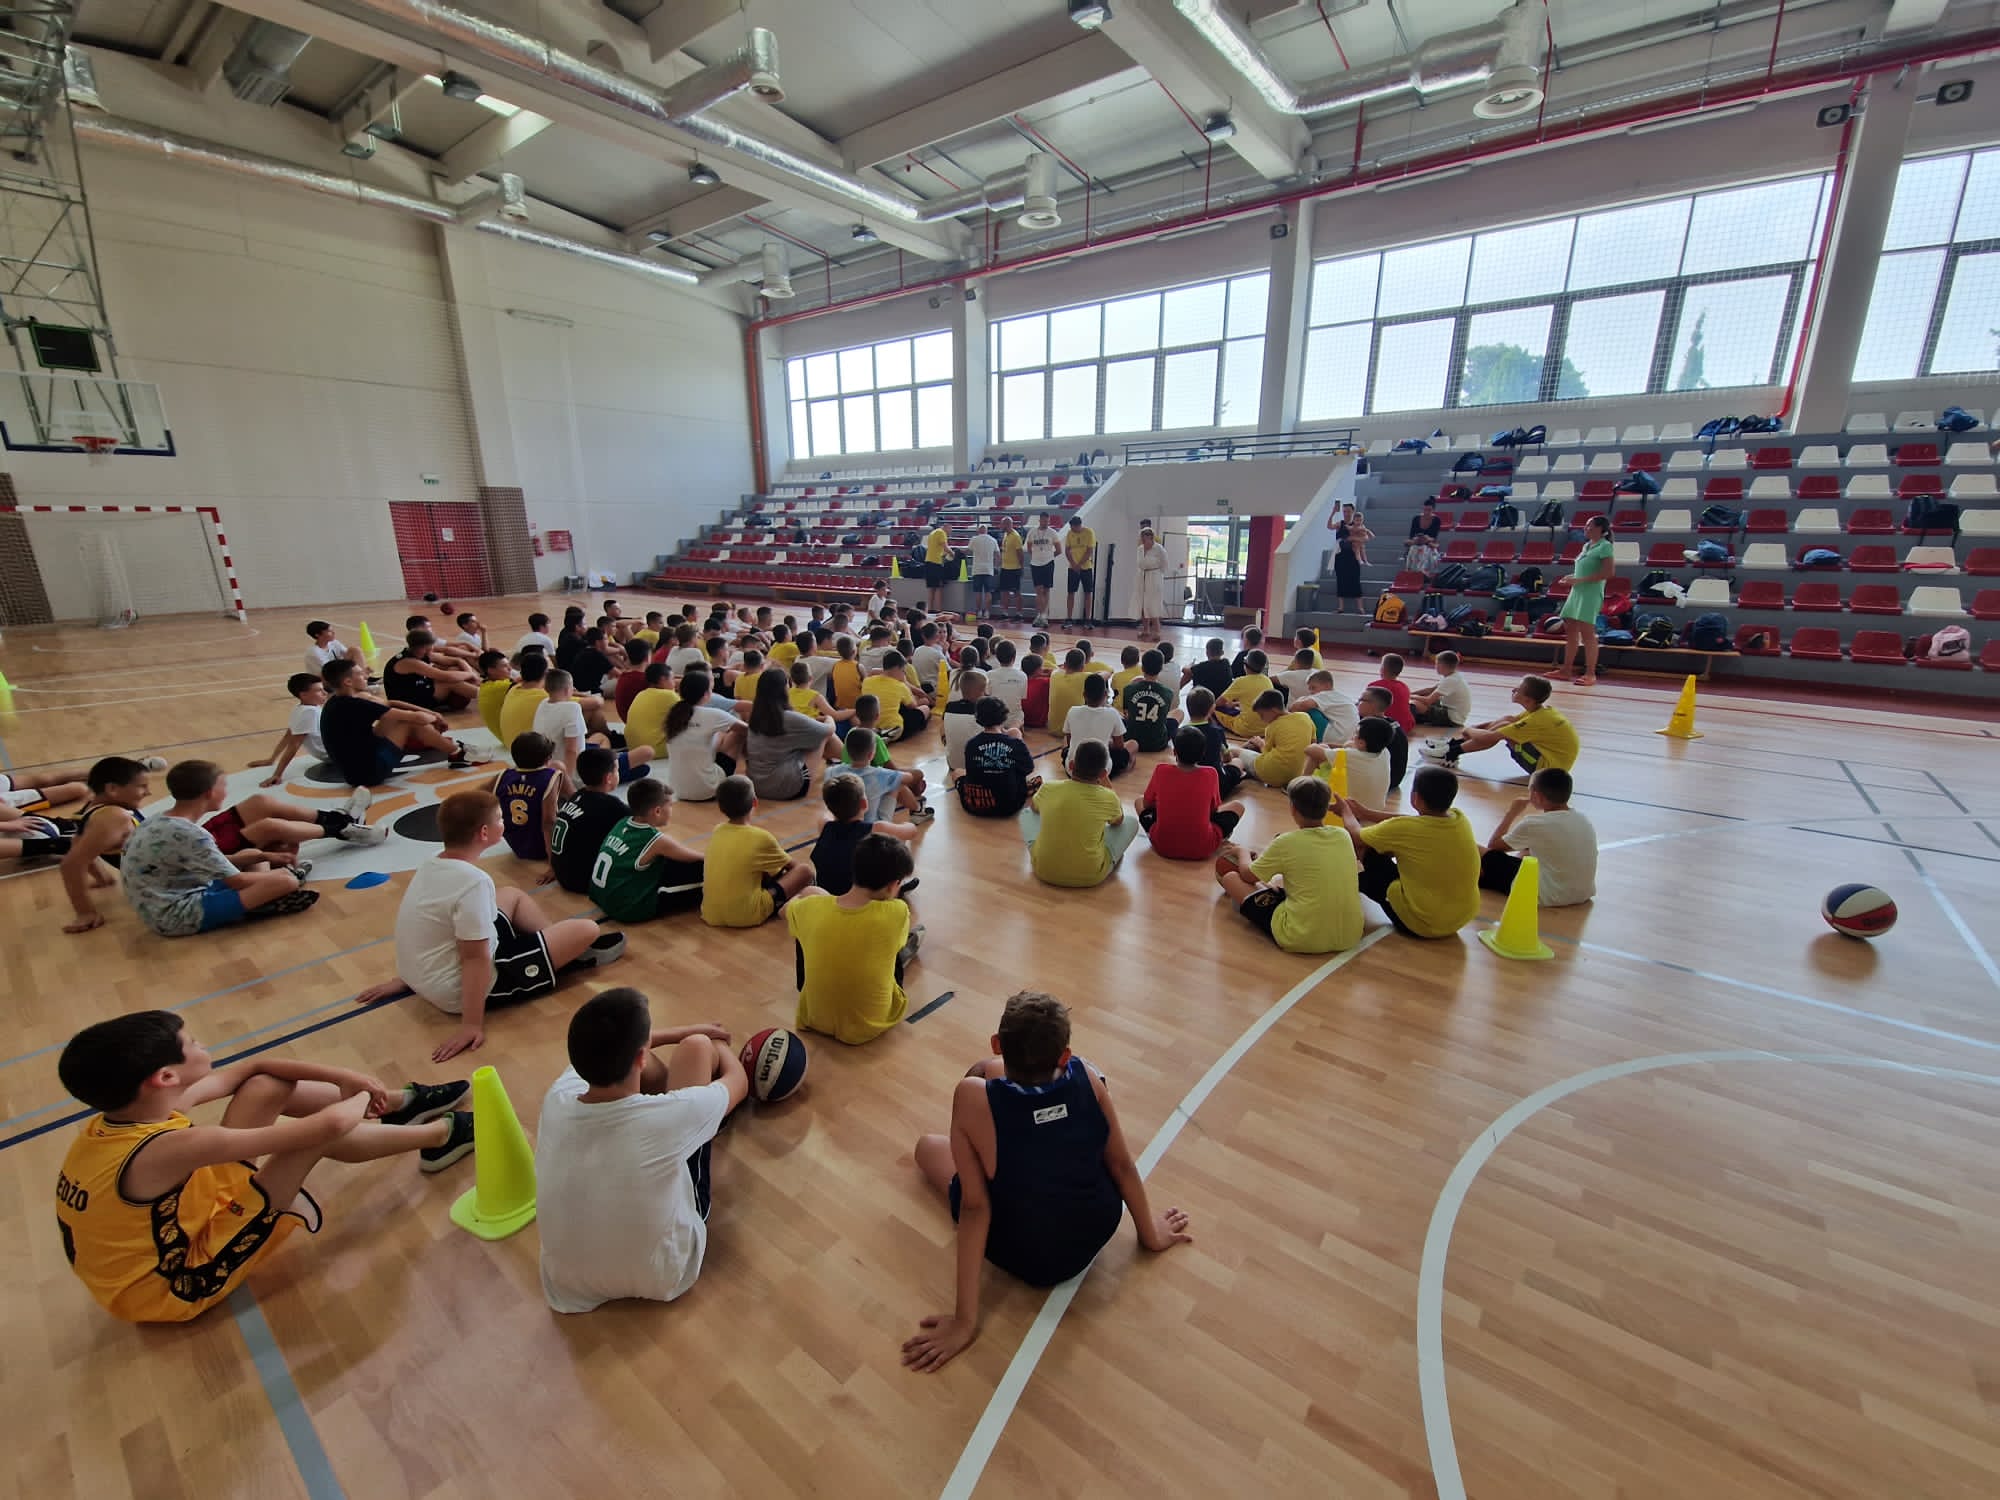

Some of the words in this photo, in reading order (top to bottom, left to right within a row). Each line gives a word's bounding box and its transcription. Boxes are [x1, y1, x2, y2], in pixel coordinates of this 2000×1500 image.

[1135, 702, 1159, 723] 34
[507, 783, 536, 798] JAMES
[510, 799, 529, 825] 6
[559, 801, 584, 820] ATUM
[591, 851, 613, 889] 0
